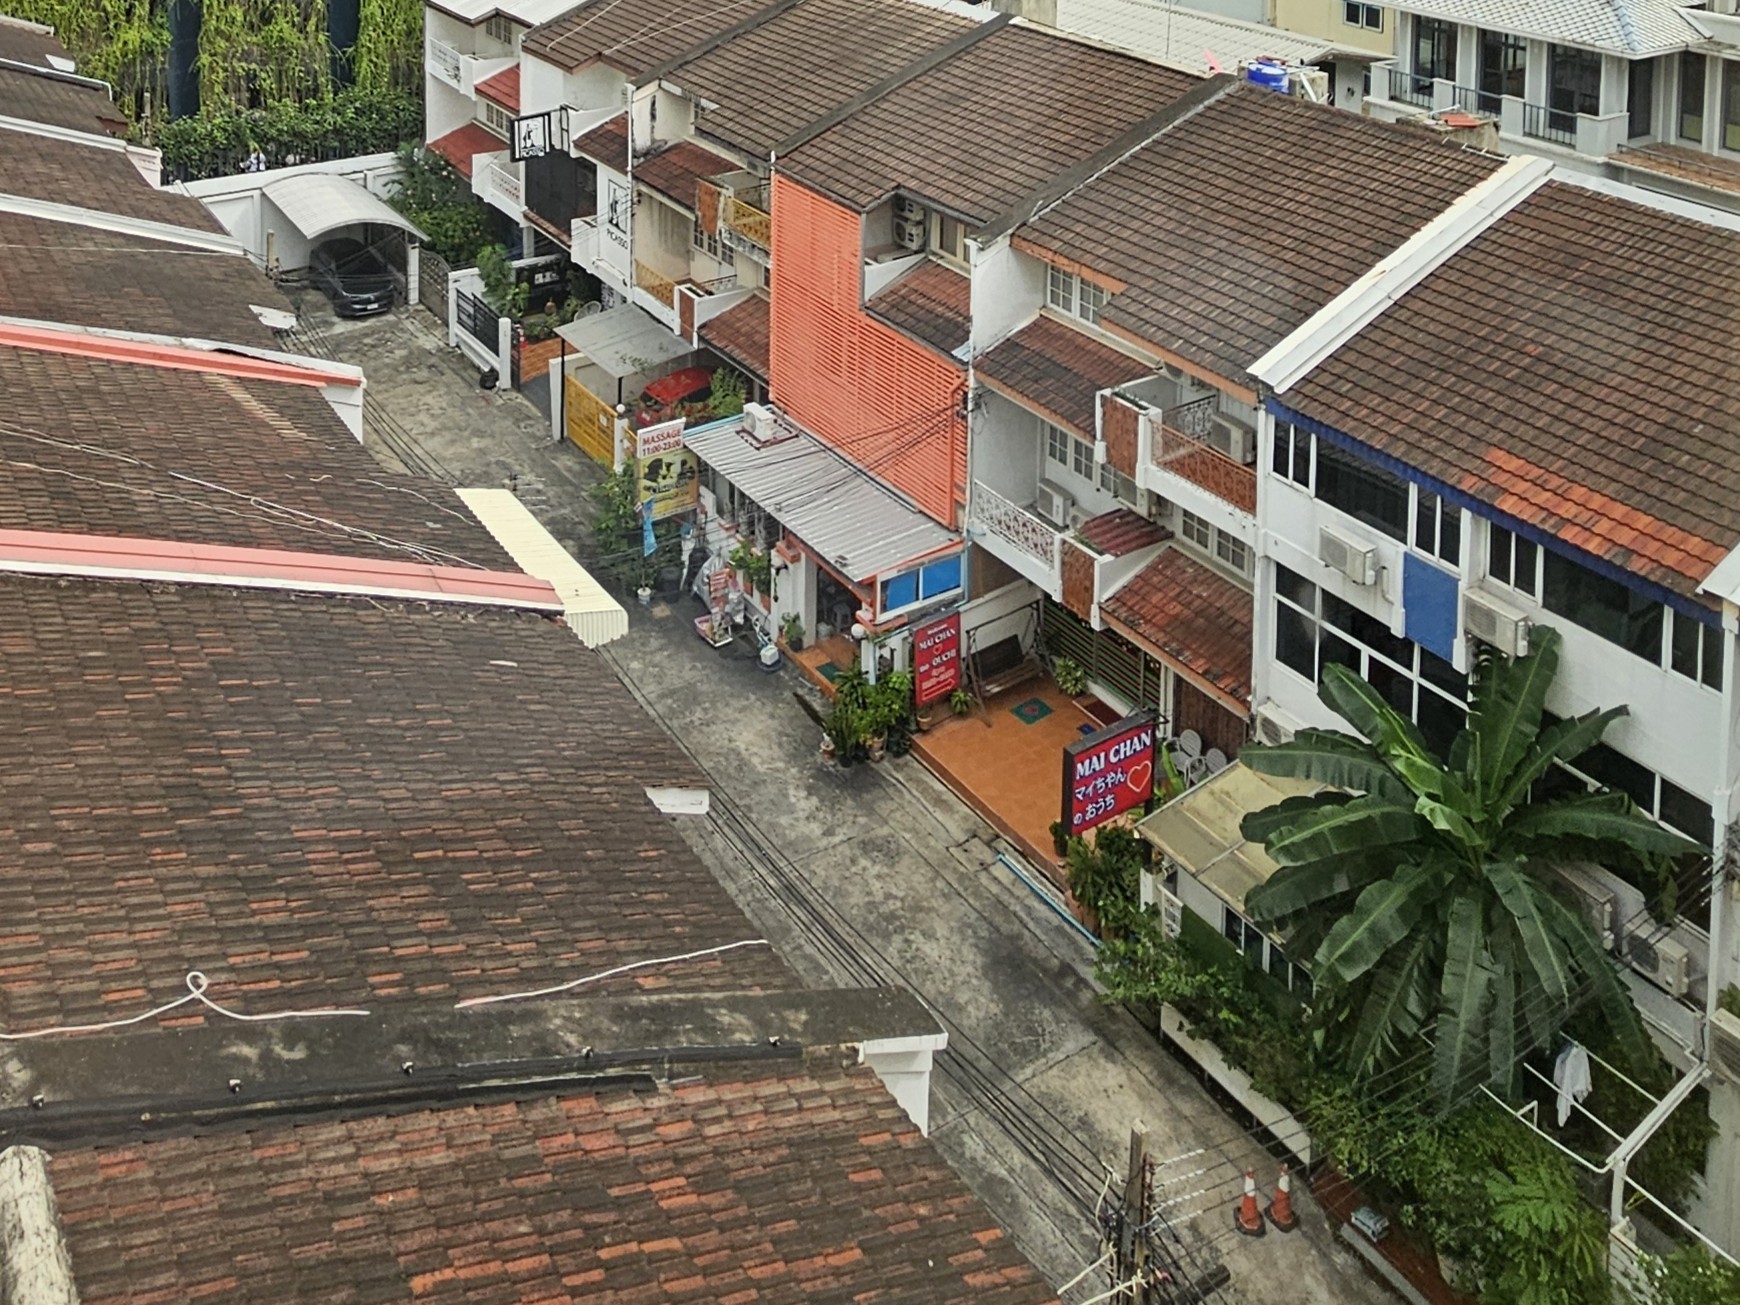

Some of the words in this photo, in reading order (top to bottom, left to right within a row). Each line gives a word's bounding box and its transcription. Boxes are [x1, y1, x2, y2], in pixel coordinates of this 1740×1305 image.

[642, 430, 681, 446] MASSAGE
[935, 629, 956, 643] CHAN
[1076, 752, 1106, 780] MAI
[1109, 730, 1151, 763] CHAN
